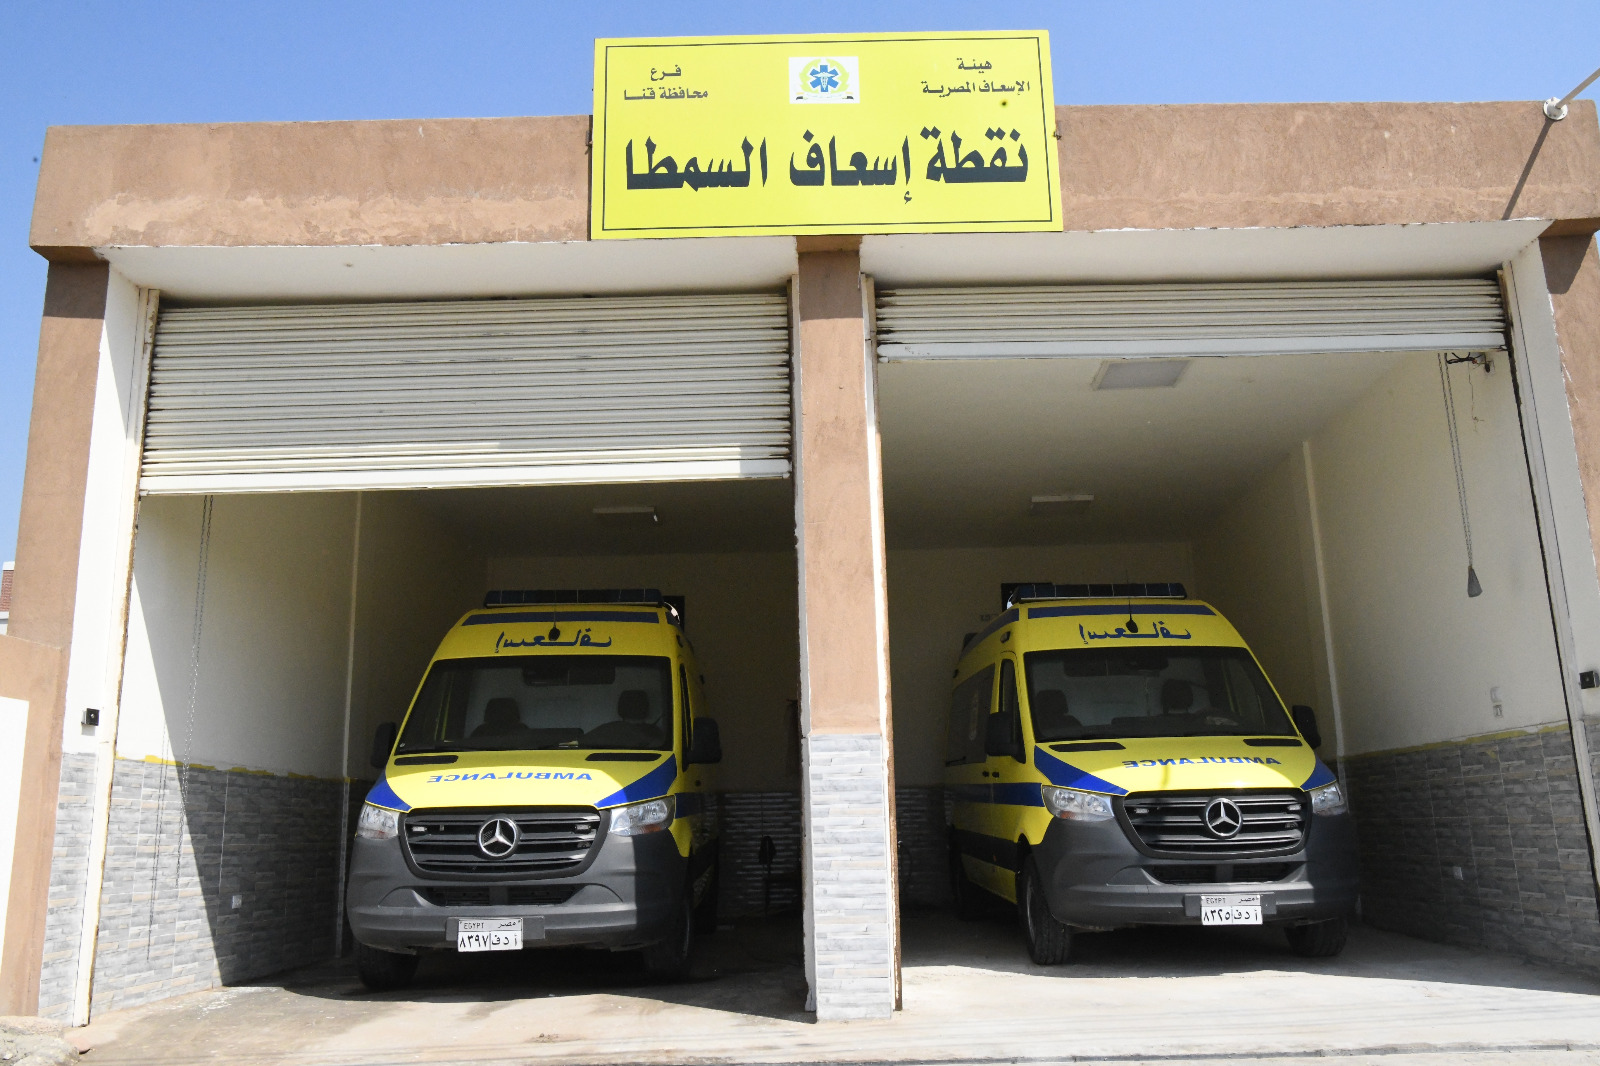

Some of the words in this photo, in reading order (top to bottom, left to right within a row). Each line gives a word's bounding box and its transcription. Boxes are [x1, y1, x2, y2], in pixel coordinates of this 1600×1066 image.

[650, 64, 682, 82] فرع
[623, 87, 656, 101] قنا
[658, 86, 709, 100] محافظة
[920, 80, 976, 98] المصرية
[978, 79, 1030, 96] الإسعاف
[919, 125, 1029, 184] نقطة
[625, 135, 768, 193] السمطا
[789, 129, 913, 205] إسعاف
[463, 922, 485, 930] EGYPT
[498, 921, 517, 929] مصر
